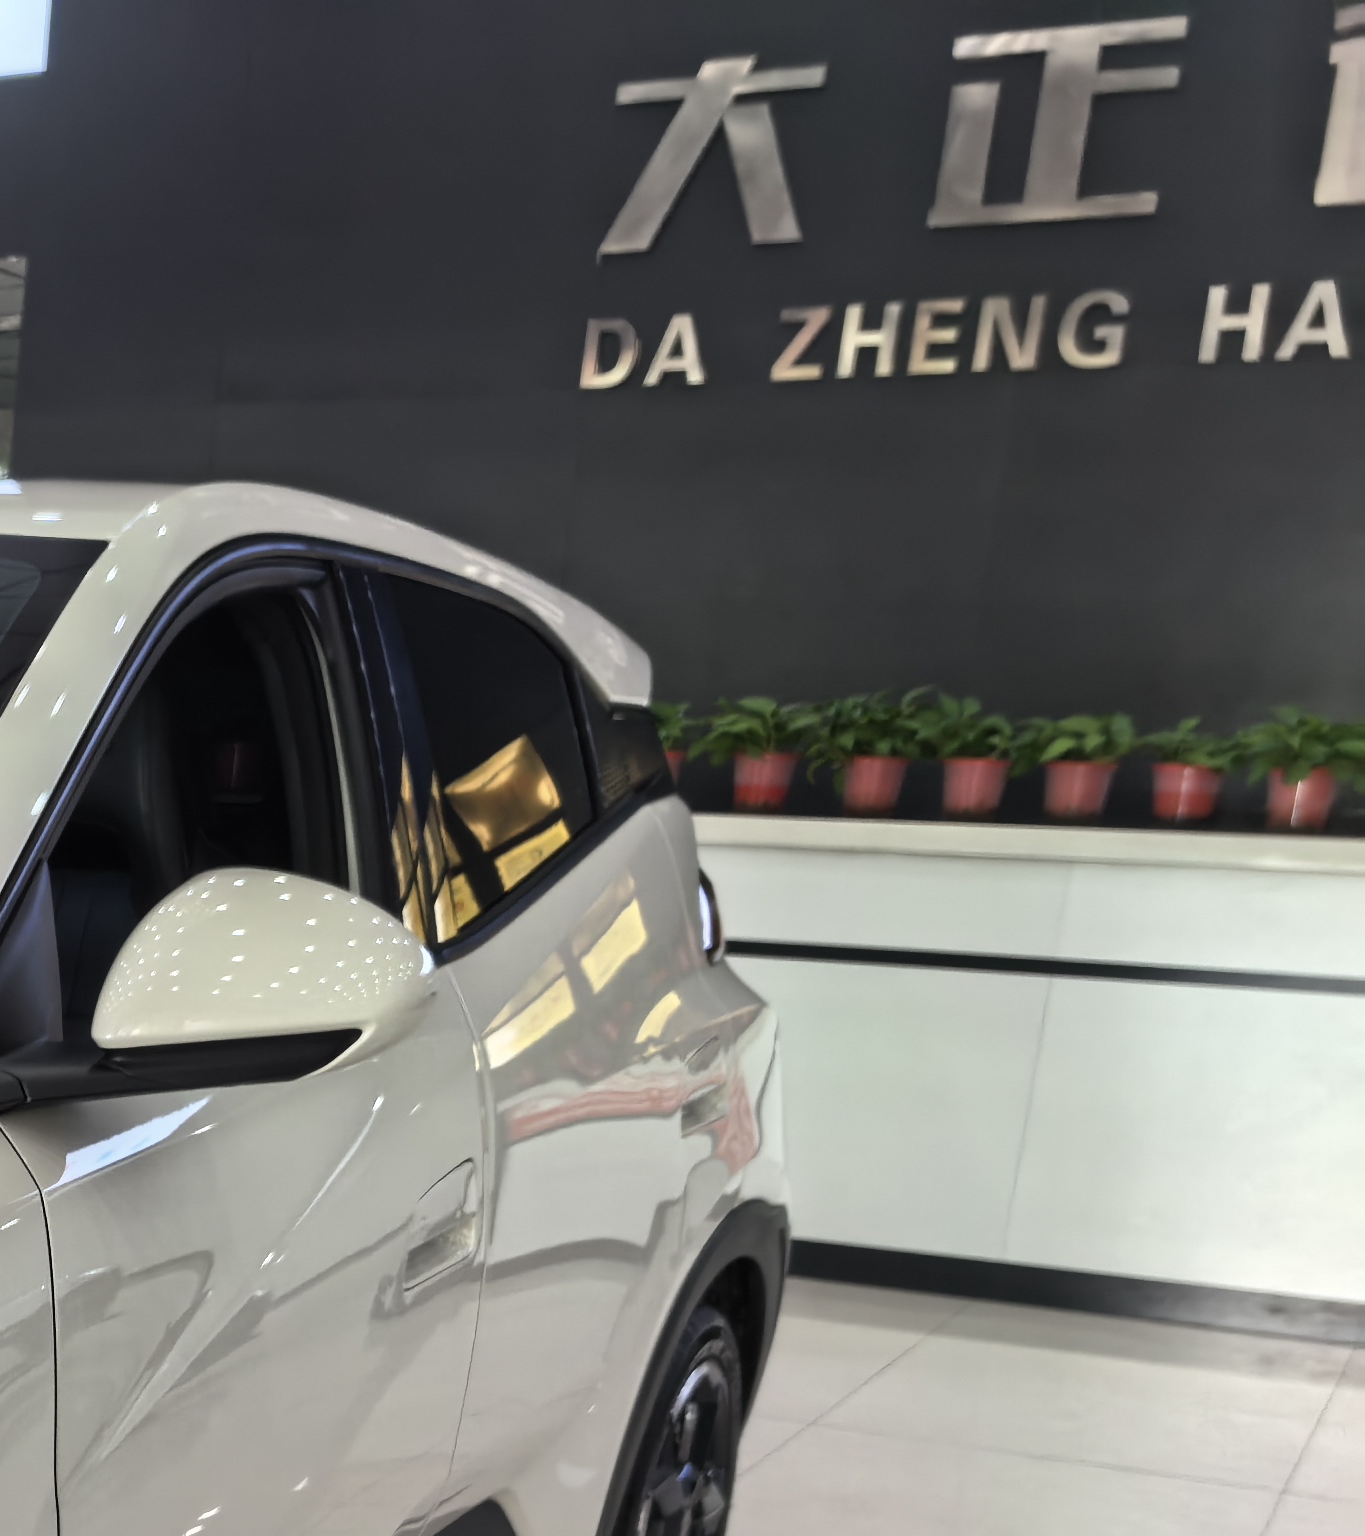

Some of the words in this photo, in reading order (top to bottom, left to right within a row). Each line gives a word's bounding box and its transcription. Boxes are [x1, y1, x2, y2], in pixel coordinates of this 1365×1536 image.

[597, 3, 1365, 263] 大正
[579, 312, 707, 390] DA
[770, 289, 1131, 383] ZHENG
[1197, 280, 1351, 363] HA
